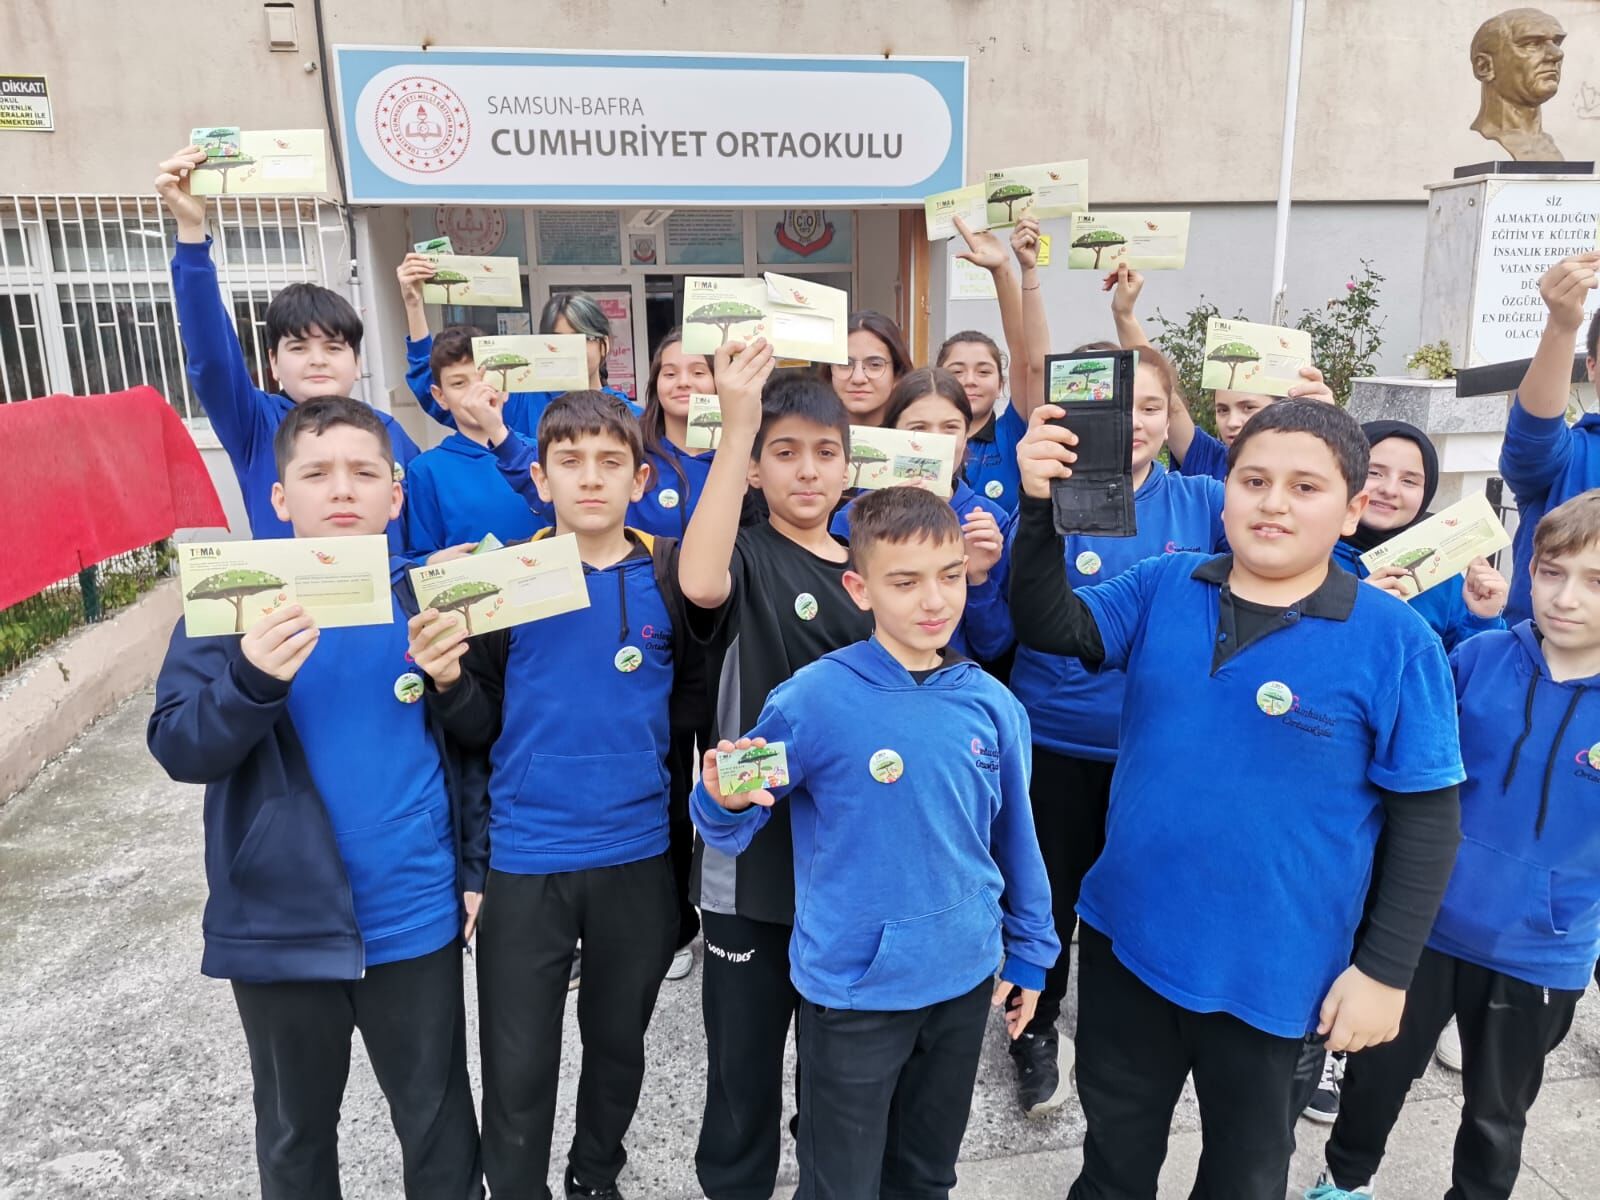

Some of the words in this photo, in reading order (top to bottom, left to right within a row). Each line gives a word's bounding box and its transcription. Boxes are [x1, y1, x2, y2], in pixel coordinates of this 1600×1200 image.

[2, 79, 45, 93] DİKKAT!
[487, 95, 645, 116] SAMSUN-BAFRA
[491, 123, 707, 157] CUMHURİYET
[716, 131, 903, 159] ORTAOKULU
[1545, 195, 1562, 207] SİZ
[1495, 213, 1544, 224] ALMAKTA
[1546, 211, 1597, 224] OLDUĞUN
[1491, 228, 1529, 240] EĞİTİM
[1532, 230, 1545, 240] VE
[1549, 228, 1591, 240] KÜLTÜR
[1493, 245, 1541, 257] İNSANLIK
[1500, 263, 1533, 274] VATAN
[1521, 279, 1541, 290] DÜŞ
[1502, 295, 1544, 306] ÖZGÜRL
[1482, 313, 1496, 323] EN
[1498, 311, 1543, 323] DEĞERLİ
[190, 547, 214, 557] TEMA
[420, 569, 440, 579] TEMA
